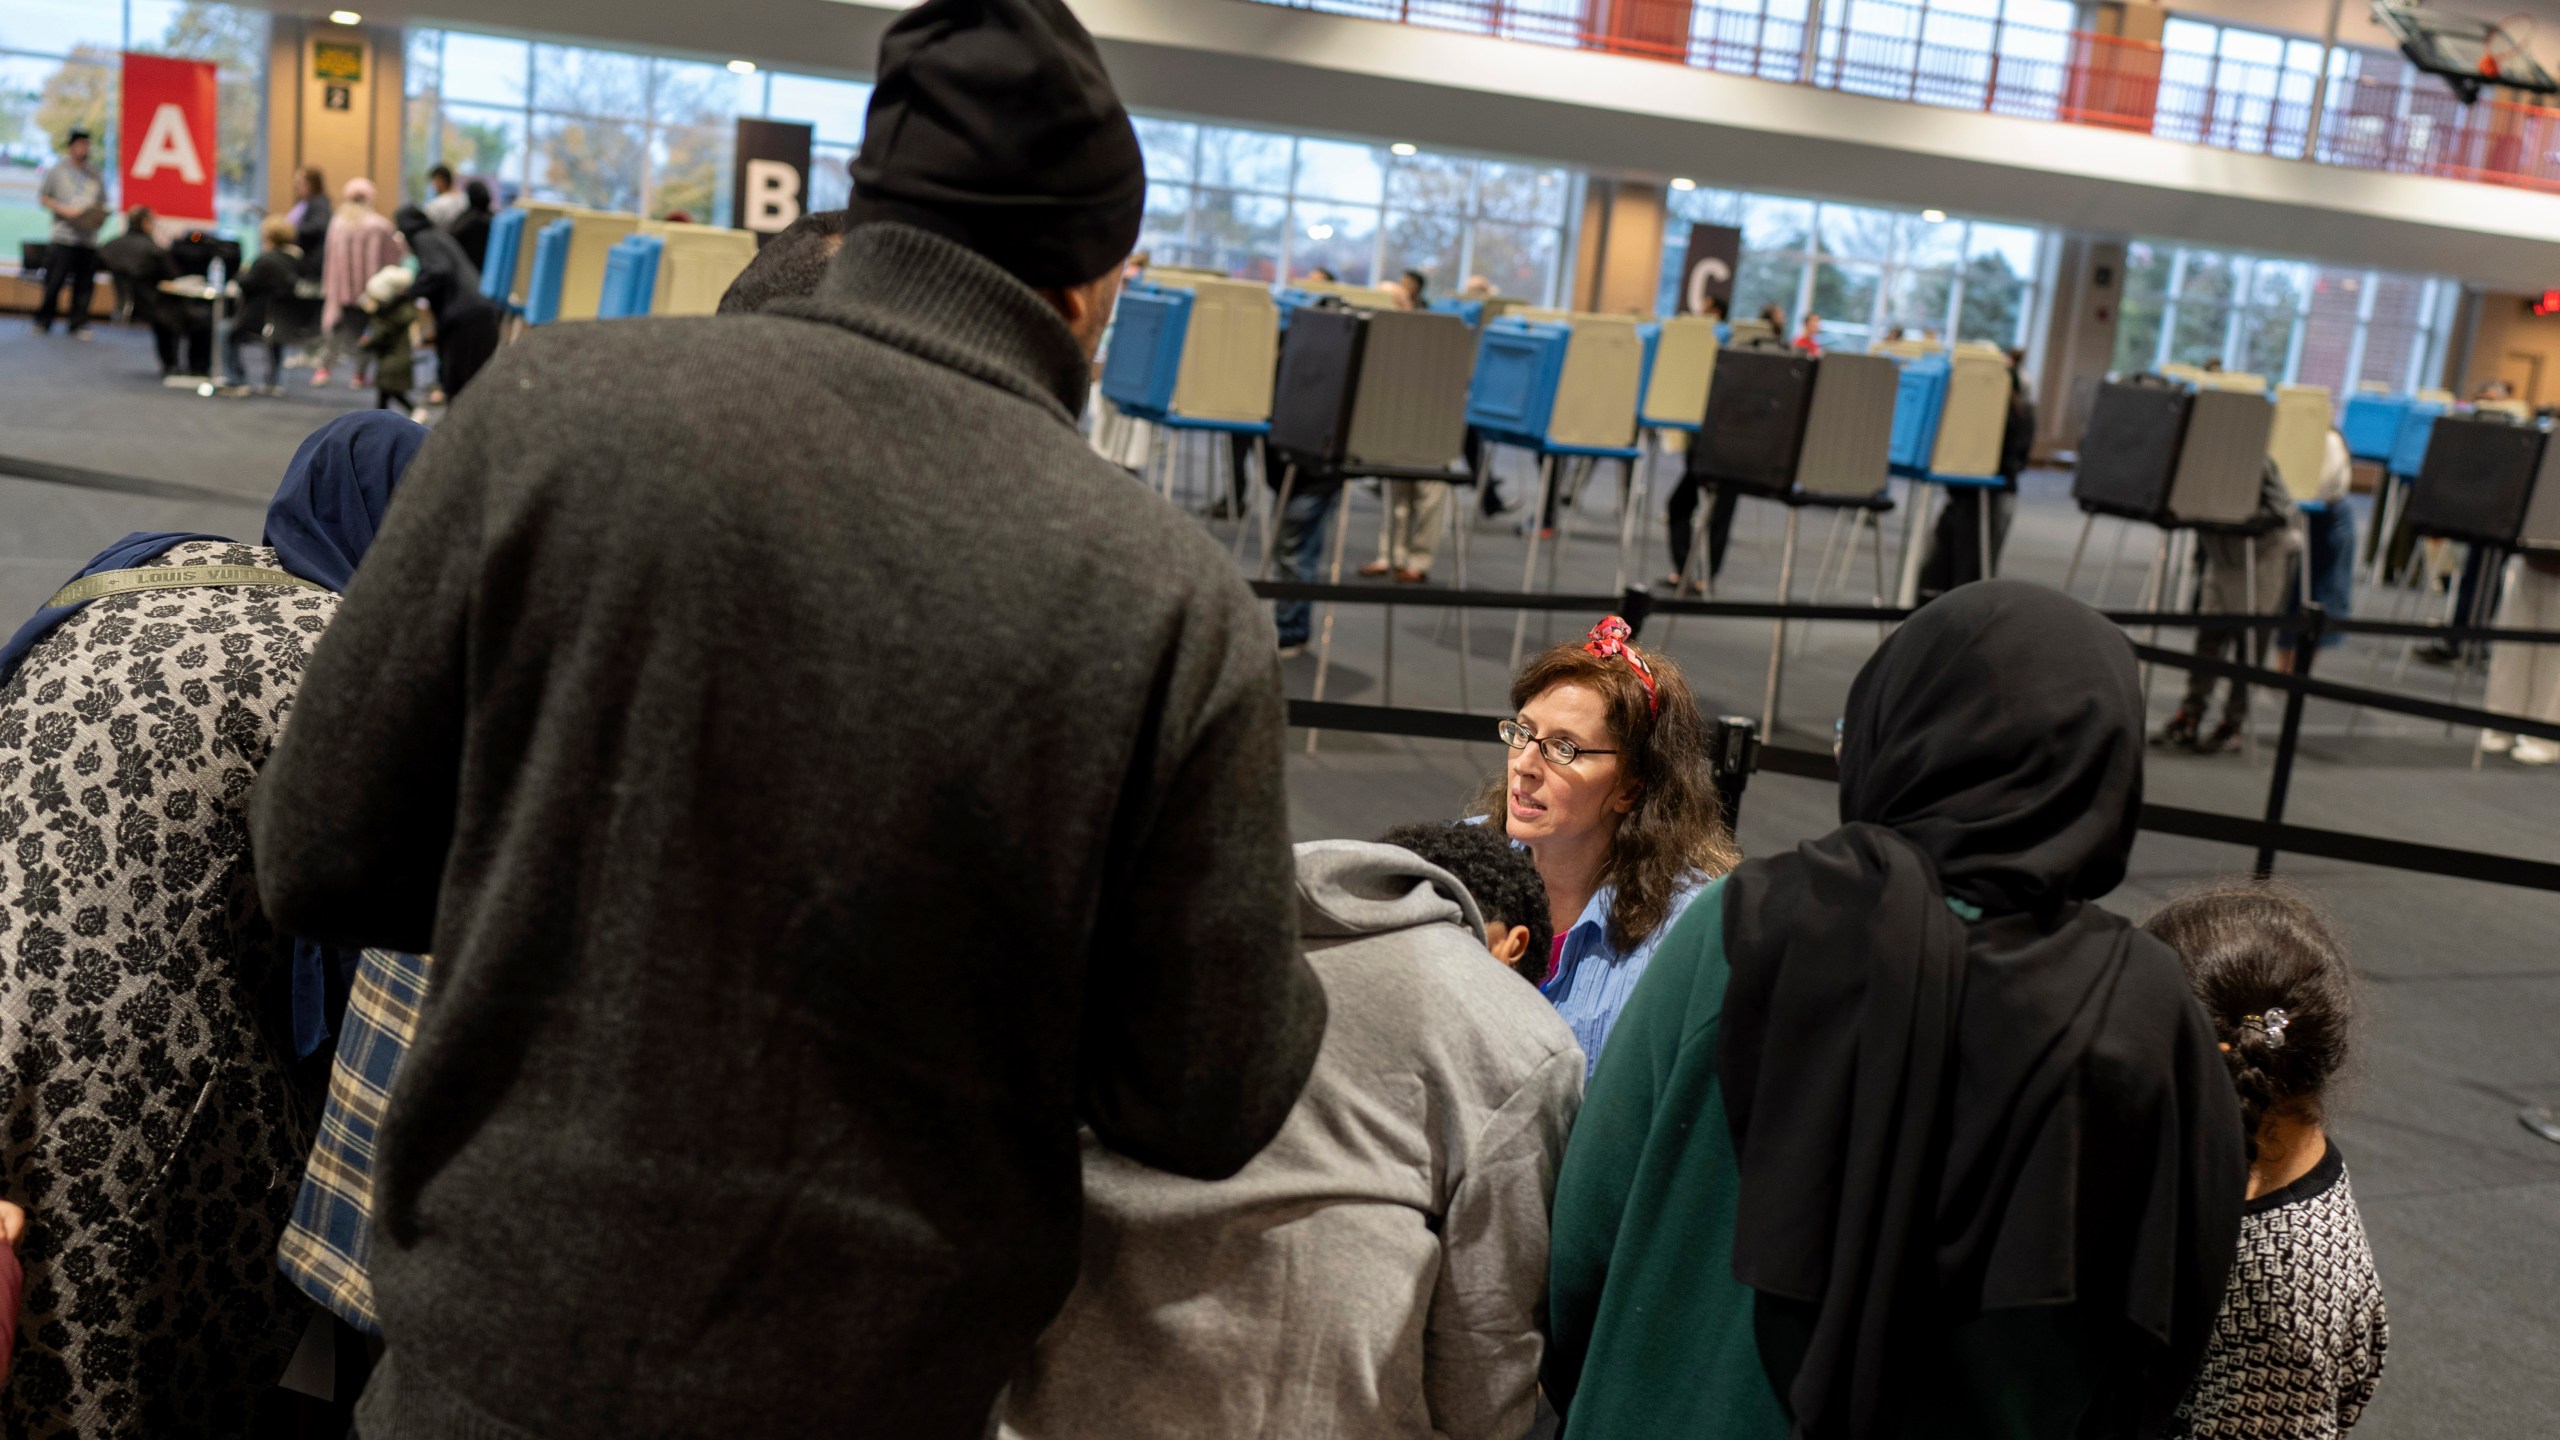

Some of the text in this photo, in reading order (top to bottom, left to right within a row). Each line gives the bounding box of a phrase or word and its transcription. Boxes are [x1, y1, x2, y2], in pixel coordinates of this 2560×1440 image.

[130, 102, 206, 185] A
[743, 158, 801, 234] B
[1686, 256, 1731, 315] C
[137, 570, 198, 584] LOUIS
